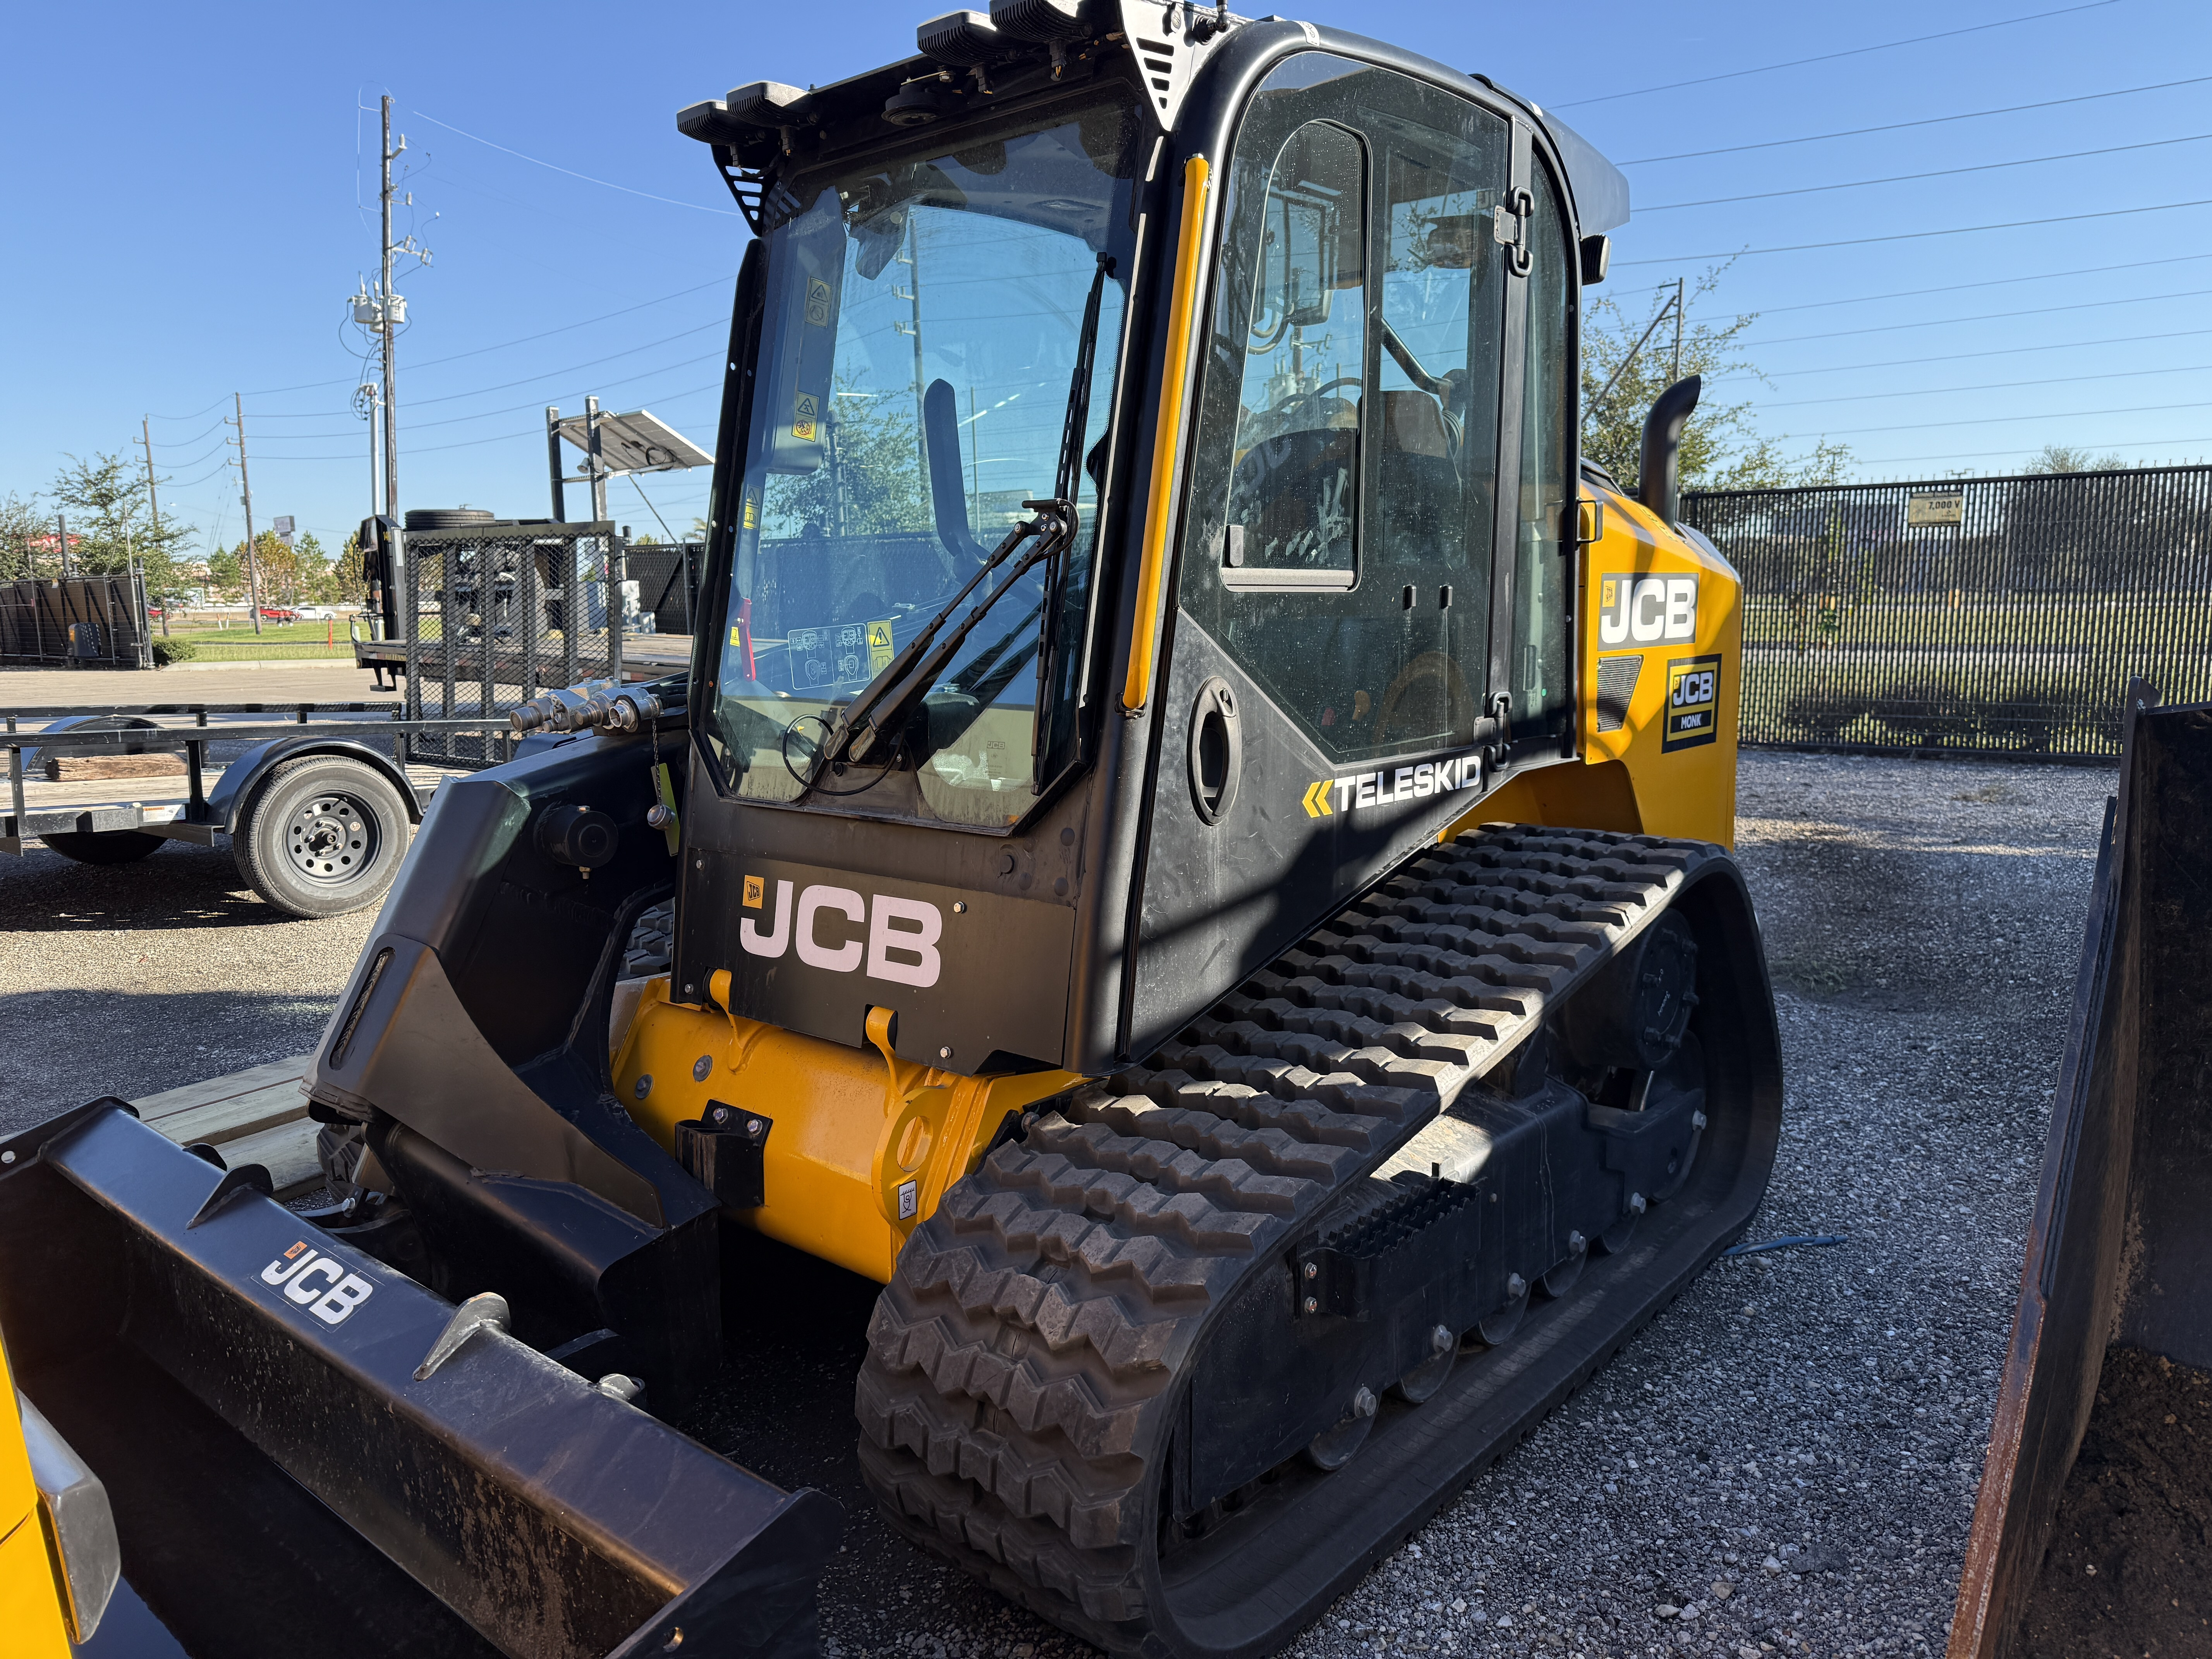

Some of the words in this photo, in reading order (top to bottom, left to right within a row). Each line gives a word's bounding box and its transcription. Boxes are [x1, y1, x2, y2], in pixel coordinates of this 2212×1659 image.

[1955, 500, 1960, 508] V
[1601, 579, 1696, 644] JCB
[1673, 672, 1713, 706] JCB
[1681, 713, 1702, 730] MONK
[987, 741, 1005, 749] JCB
[1334, 756, 1481, 812] TELESKID
[748, 883, 760, 899] JCB
[740, 879, 942, 987] JCB
[261, 1249, 373, 1324] JCB
